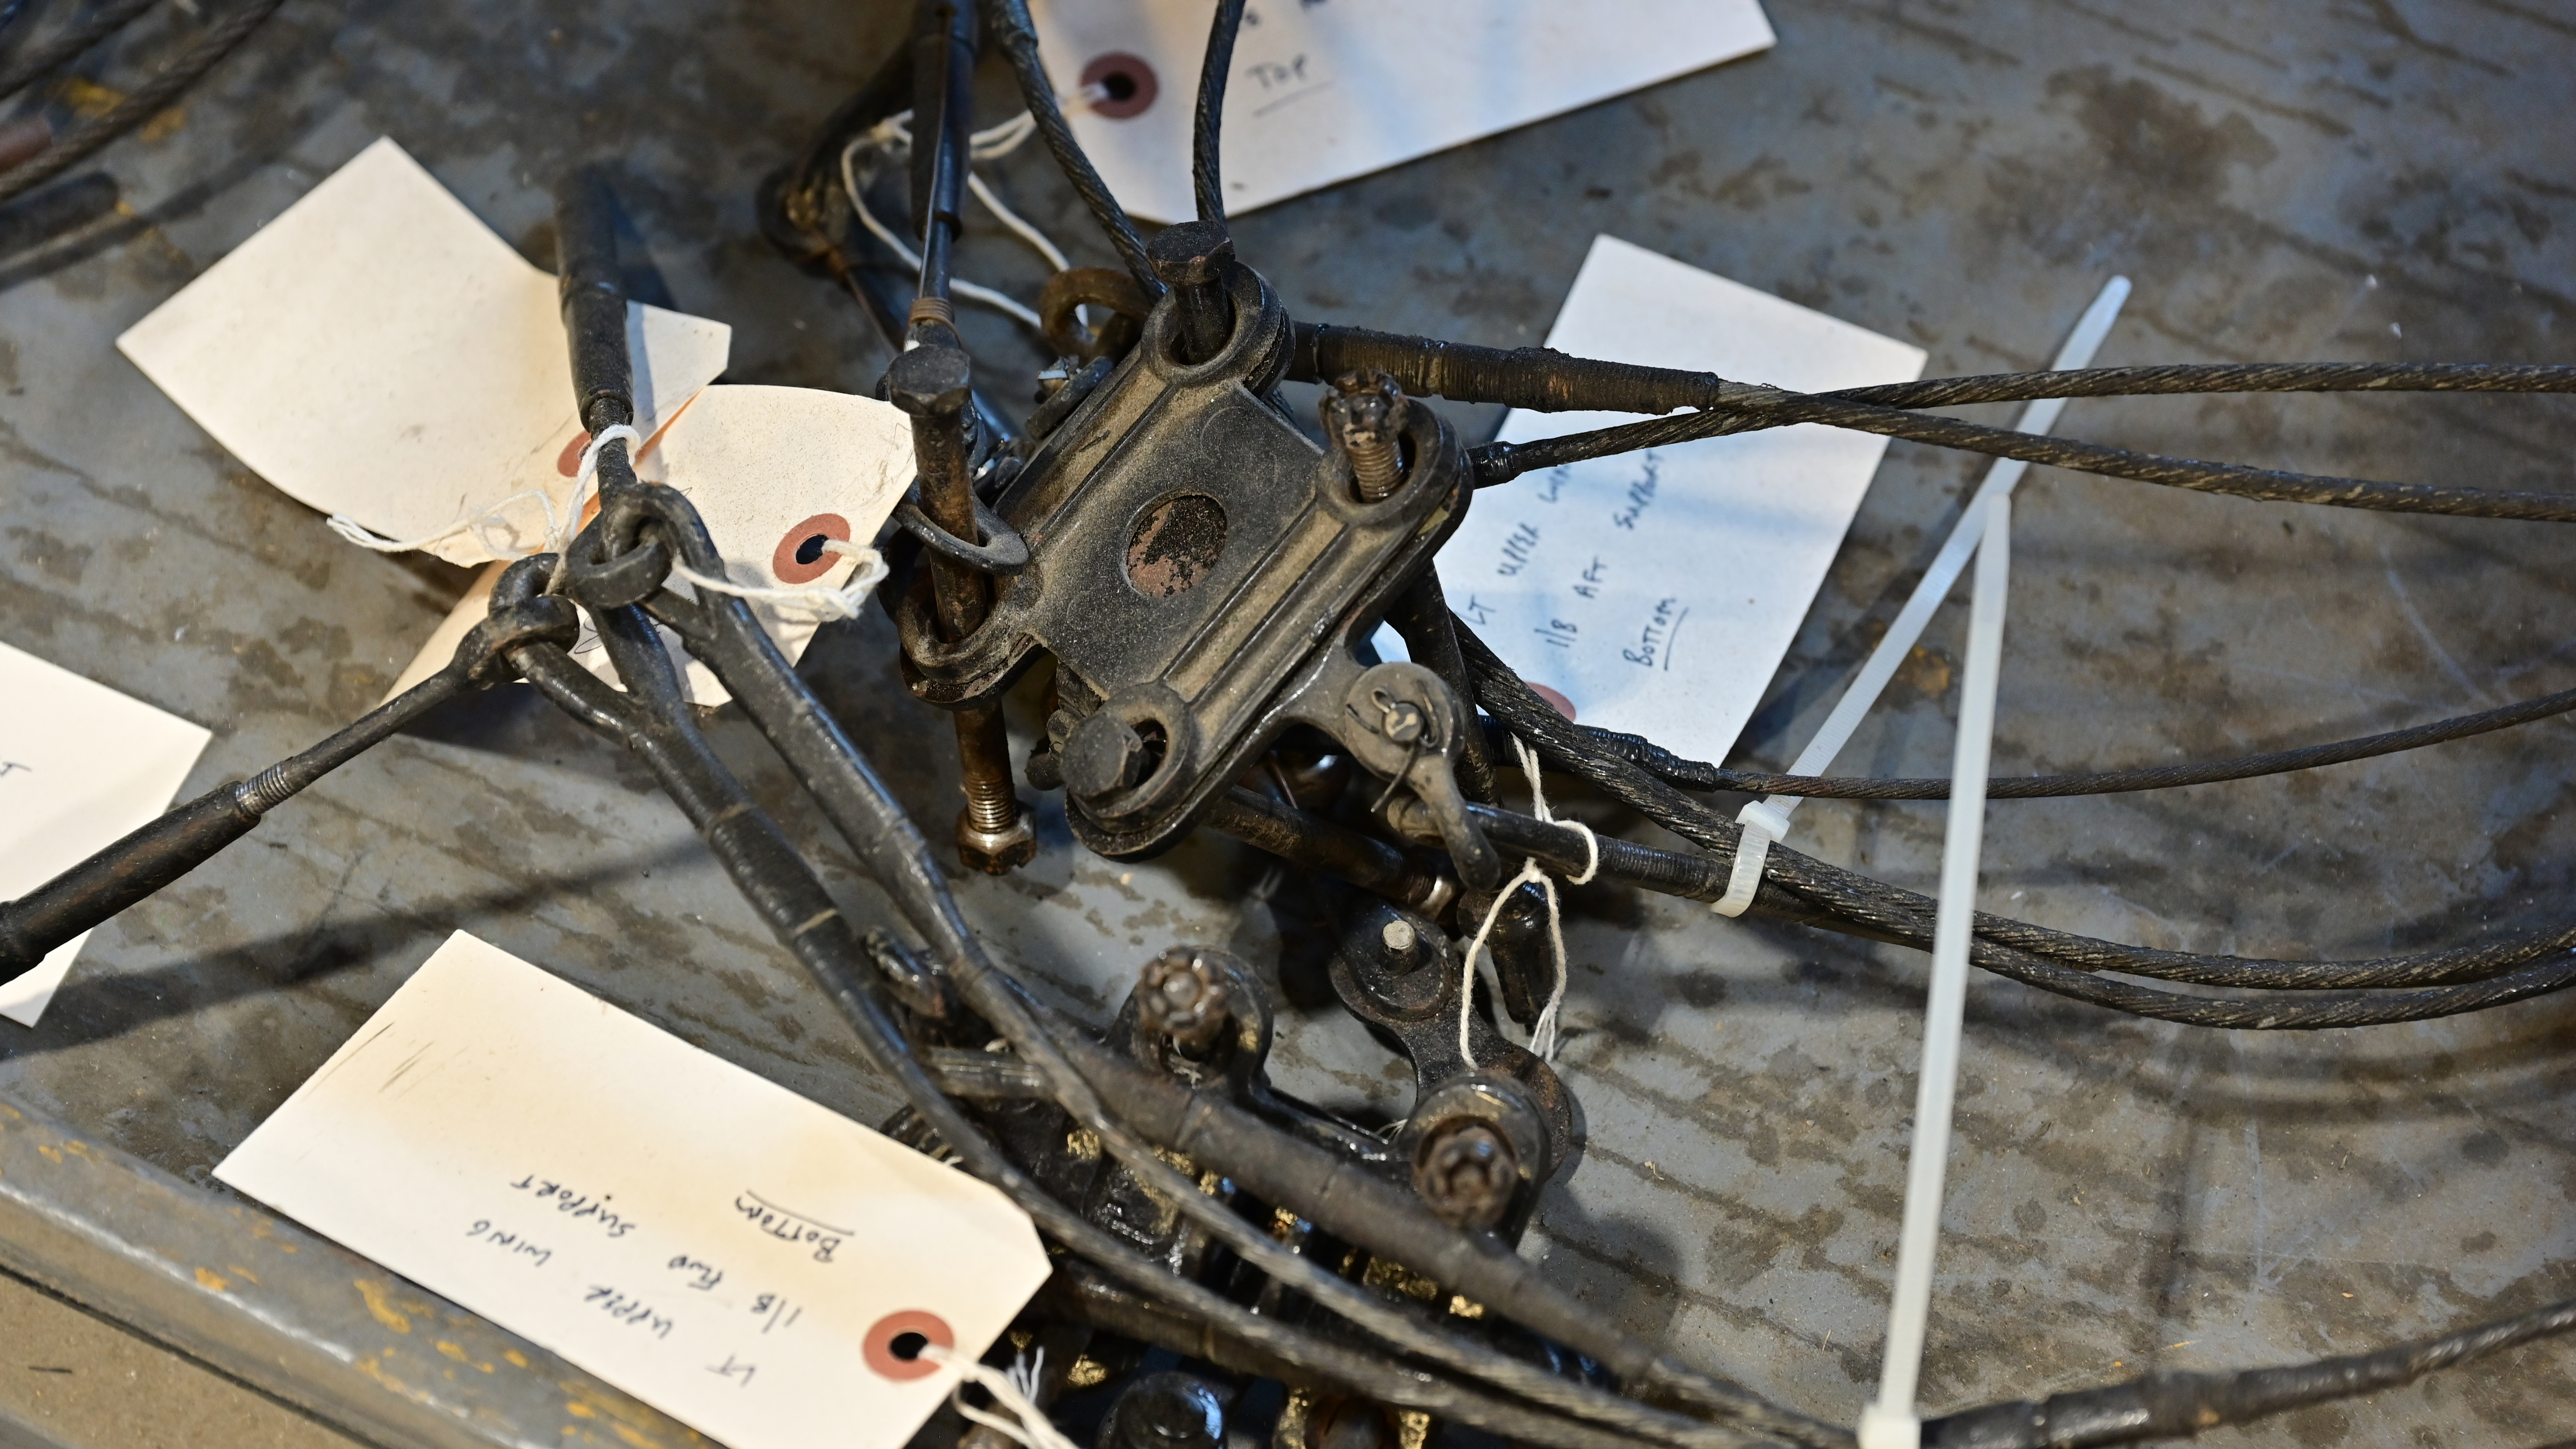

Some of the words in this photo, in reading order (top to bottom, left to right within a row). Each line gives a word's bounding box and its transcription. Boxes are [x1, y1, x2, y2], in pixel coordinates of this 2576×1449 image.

[1245, 54, 1307, 89] TOP
[1572, 556, 1609, 599] AFT
[1453, 593, 1496, 626] LT
[1622, 597, 1676, 669] BOTTOM
[510, 1174, 636, 1238] SUPPORT
[734, 1194, 842, 1263] BOTTOM
[466, 1219, 552, 1268] WING
[584, 1283, 673, 1339] UPPER
[705, 1354, 756, 1386] LT
